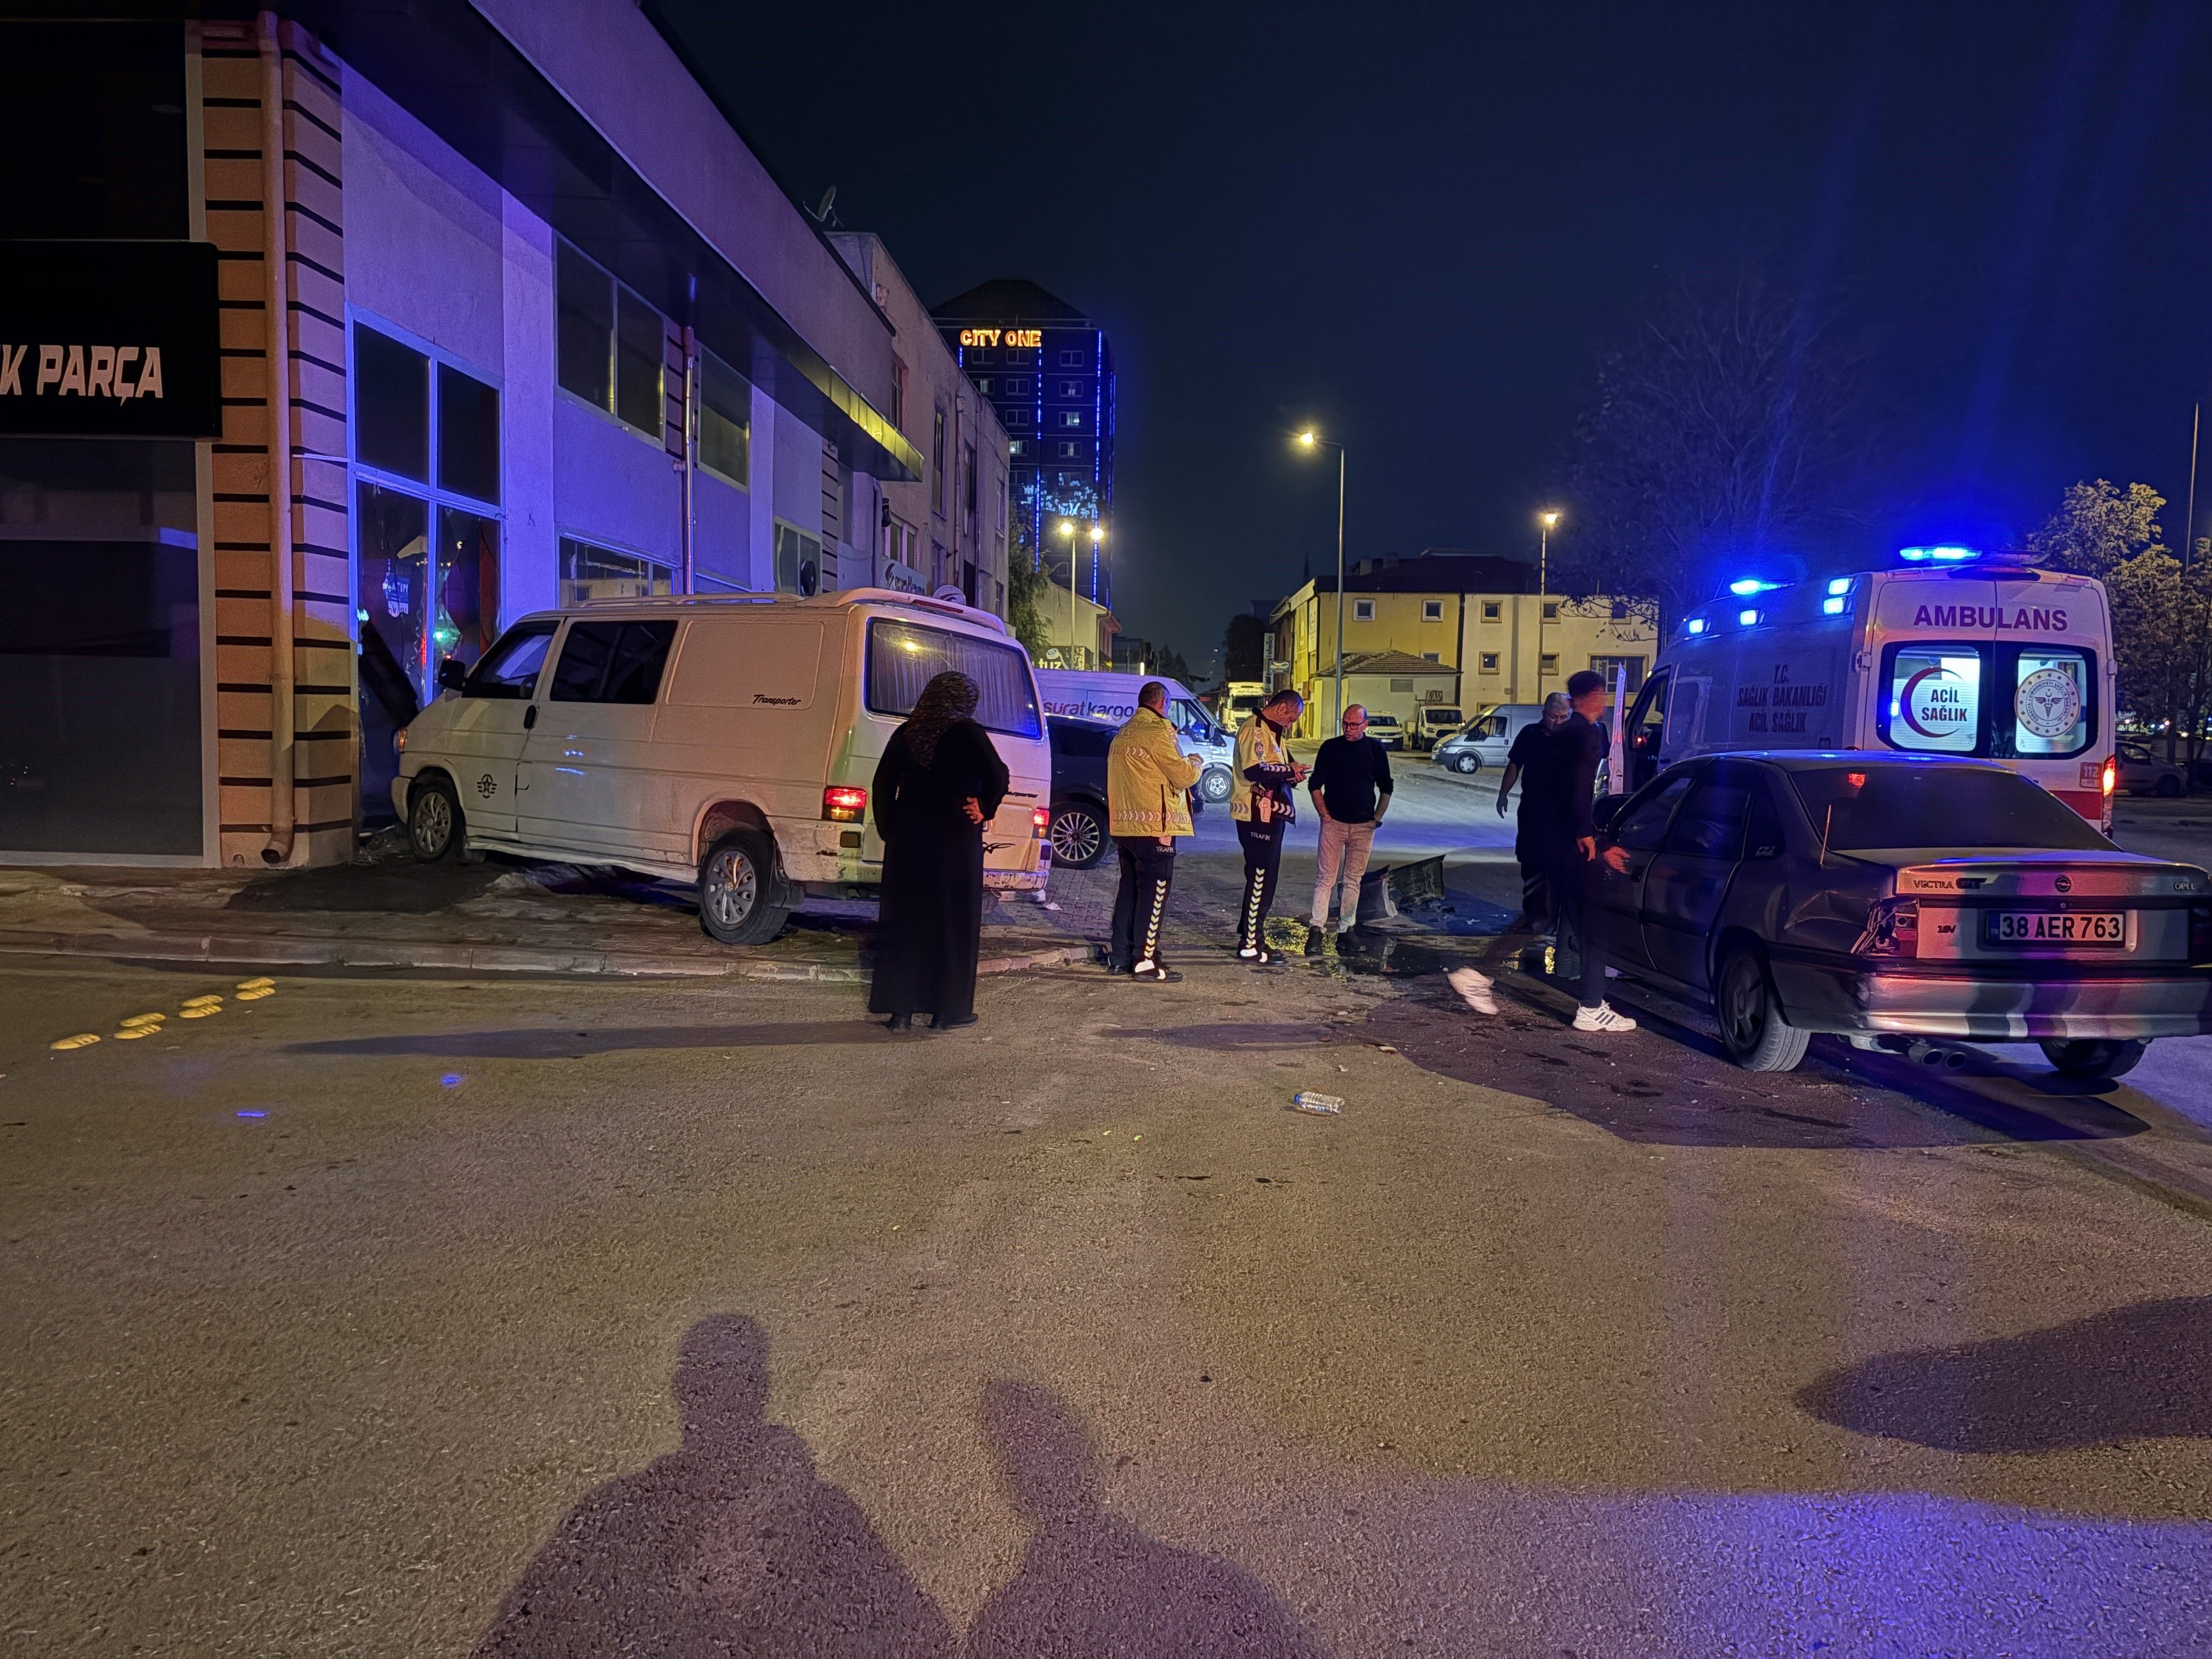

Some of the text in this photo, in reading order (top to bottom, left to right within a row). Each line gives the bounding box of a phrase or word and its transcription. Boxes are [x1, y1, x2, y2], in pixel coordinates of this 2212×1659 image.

[960, 330, 1042, 347] CITY ONE
[0, 345, 163, 407] K PARÇA
[1914, 605, 2068, 631] AMBULANS
[753, 694, 802, 706] Transporter
[1931, 686, 1960, 703] ACİL
[1921, 704, 1967, 721] SAĞLIK
[1914, 879, 1954, 889] VECTRA
[2174, 882, 2196, 890] OPEL
[2002, 917, 2028, 938] 38
[2034, 917, 2074, 938] AER
[2080, 917, 2120, 938] 763
